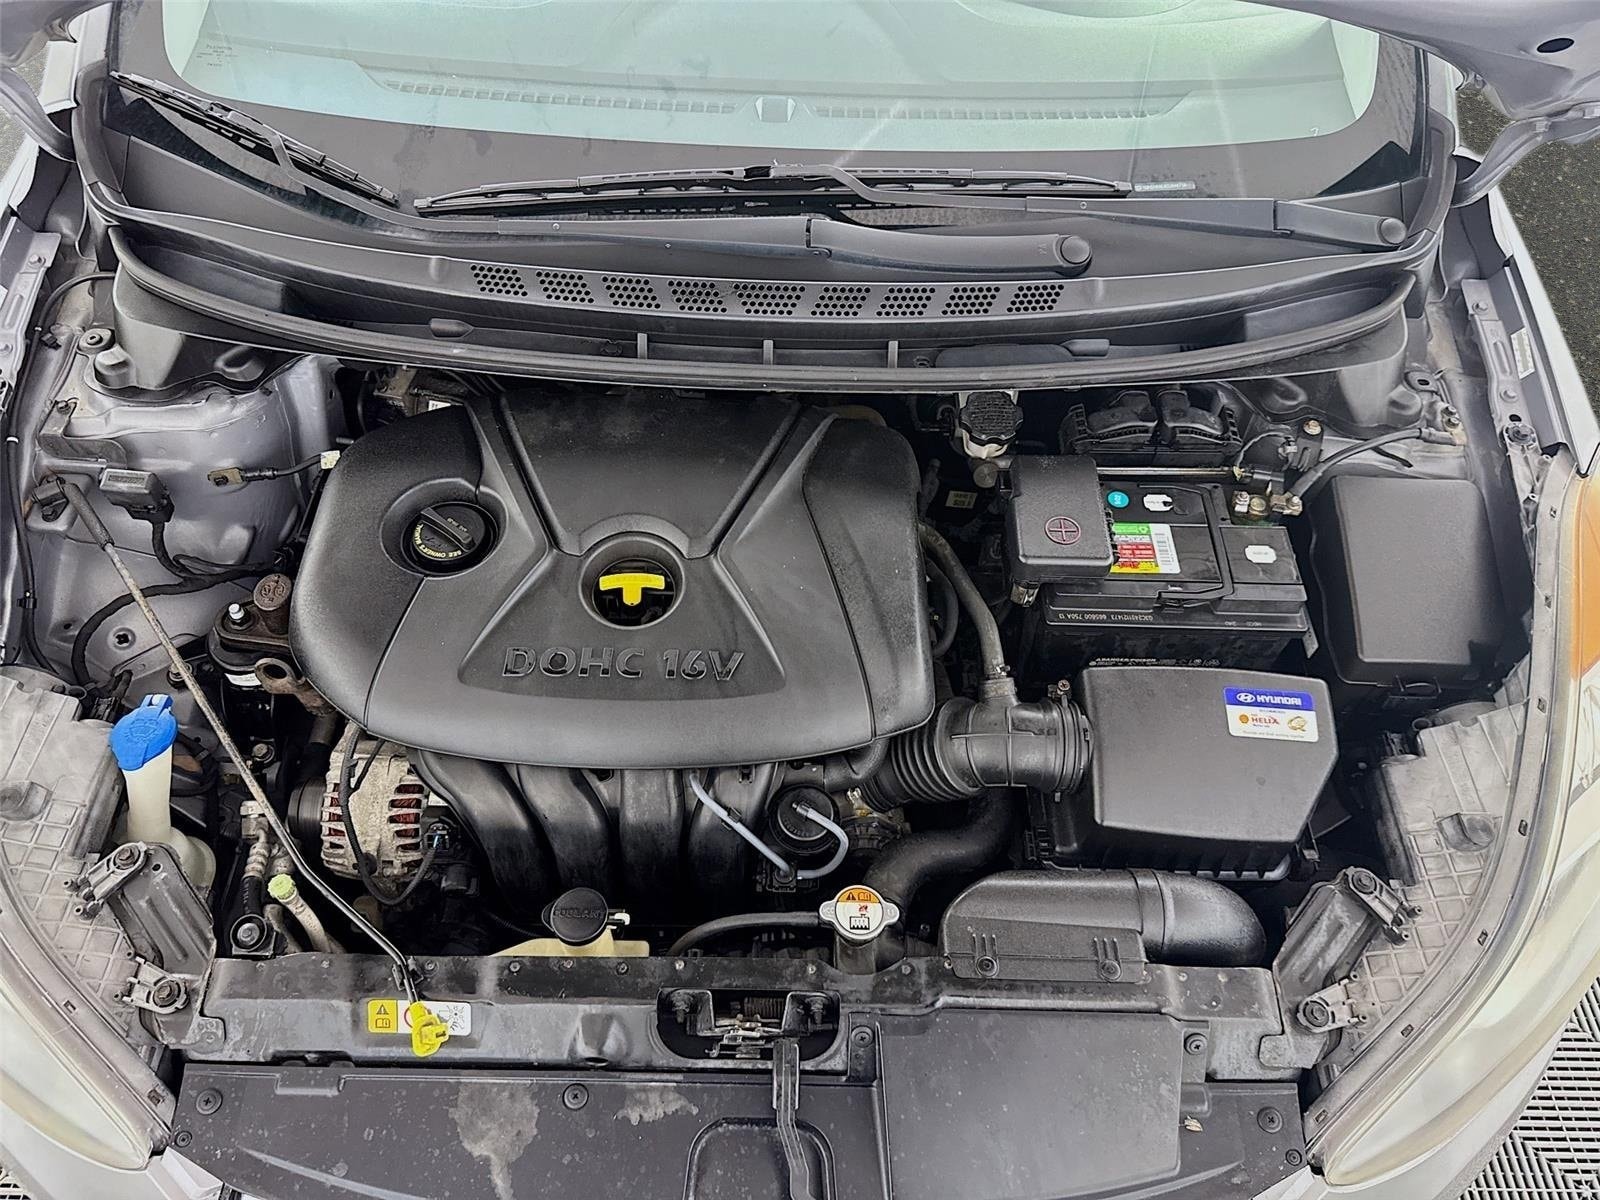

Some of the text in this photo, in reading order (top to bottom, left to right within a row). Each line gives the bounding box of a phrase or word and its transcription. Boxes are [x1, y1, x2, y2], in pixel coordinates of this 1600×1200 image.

[419, 544, 446, 558] OWNER'S
[448, 549, 462, 558] SEE
[502, 646, 745, 680] DOHC 16V
[1256, 694, 1302, 706] HYUNDAI
[1250, 716, 1280, 725] HELIX
